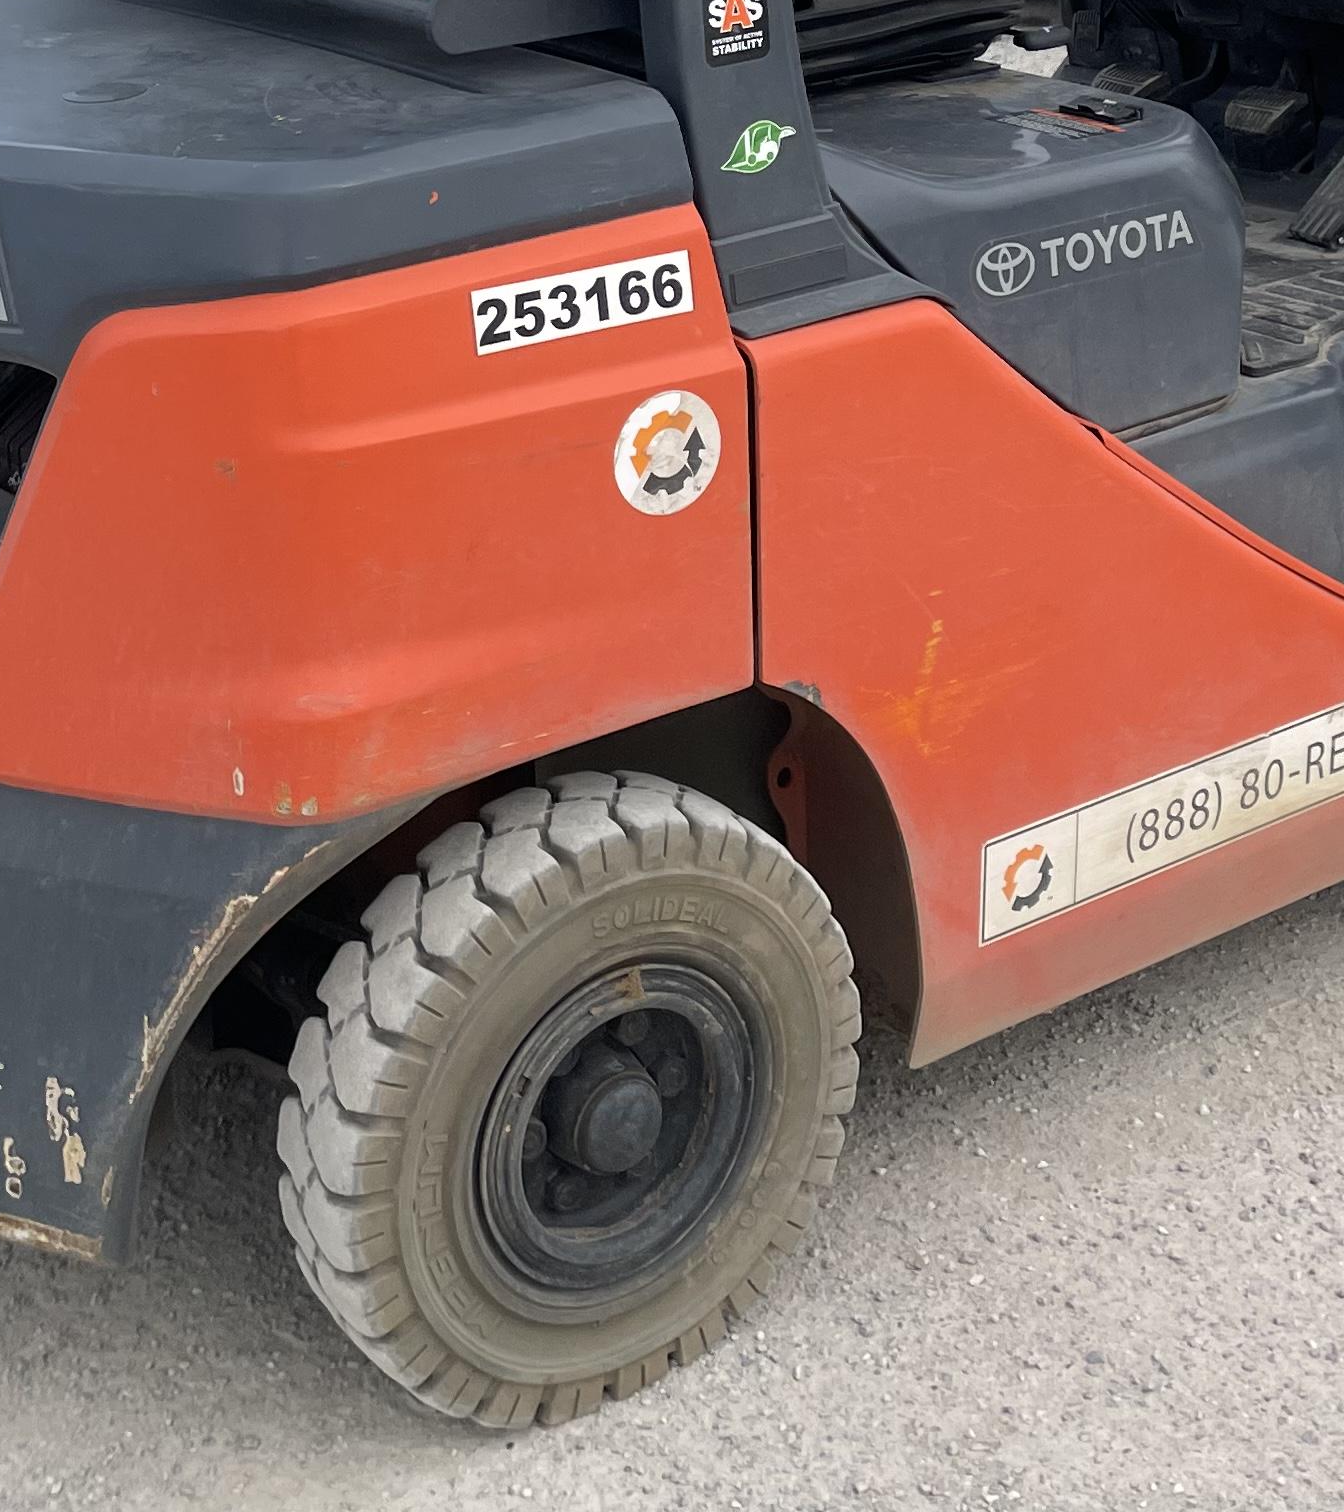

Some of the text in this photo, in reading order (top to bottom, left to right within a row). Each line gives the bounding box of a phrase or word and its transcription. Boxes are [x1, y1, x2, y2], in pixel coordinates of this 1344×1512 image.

[712, 37, 764, 56] STABILITY
[1040, 209, 1194, 277] TOYOTA
[476, 263, 683, 347] 253166
[1125, 781, 1223, 863] (888)
[592, 896, 730, 936] SOLIDEAL
